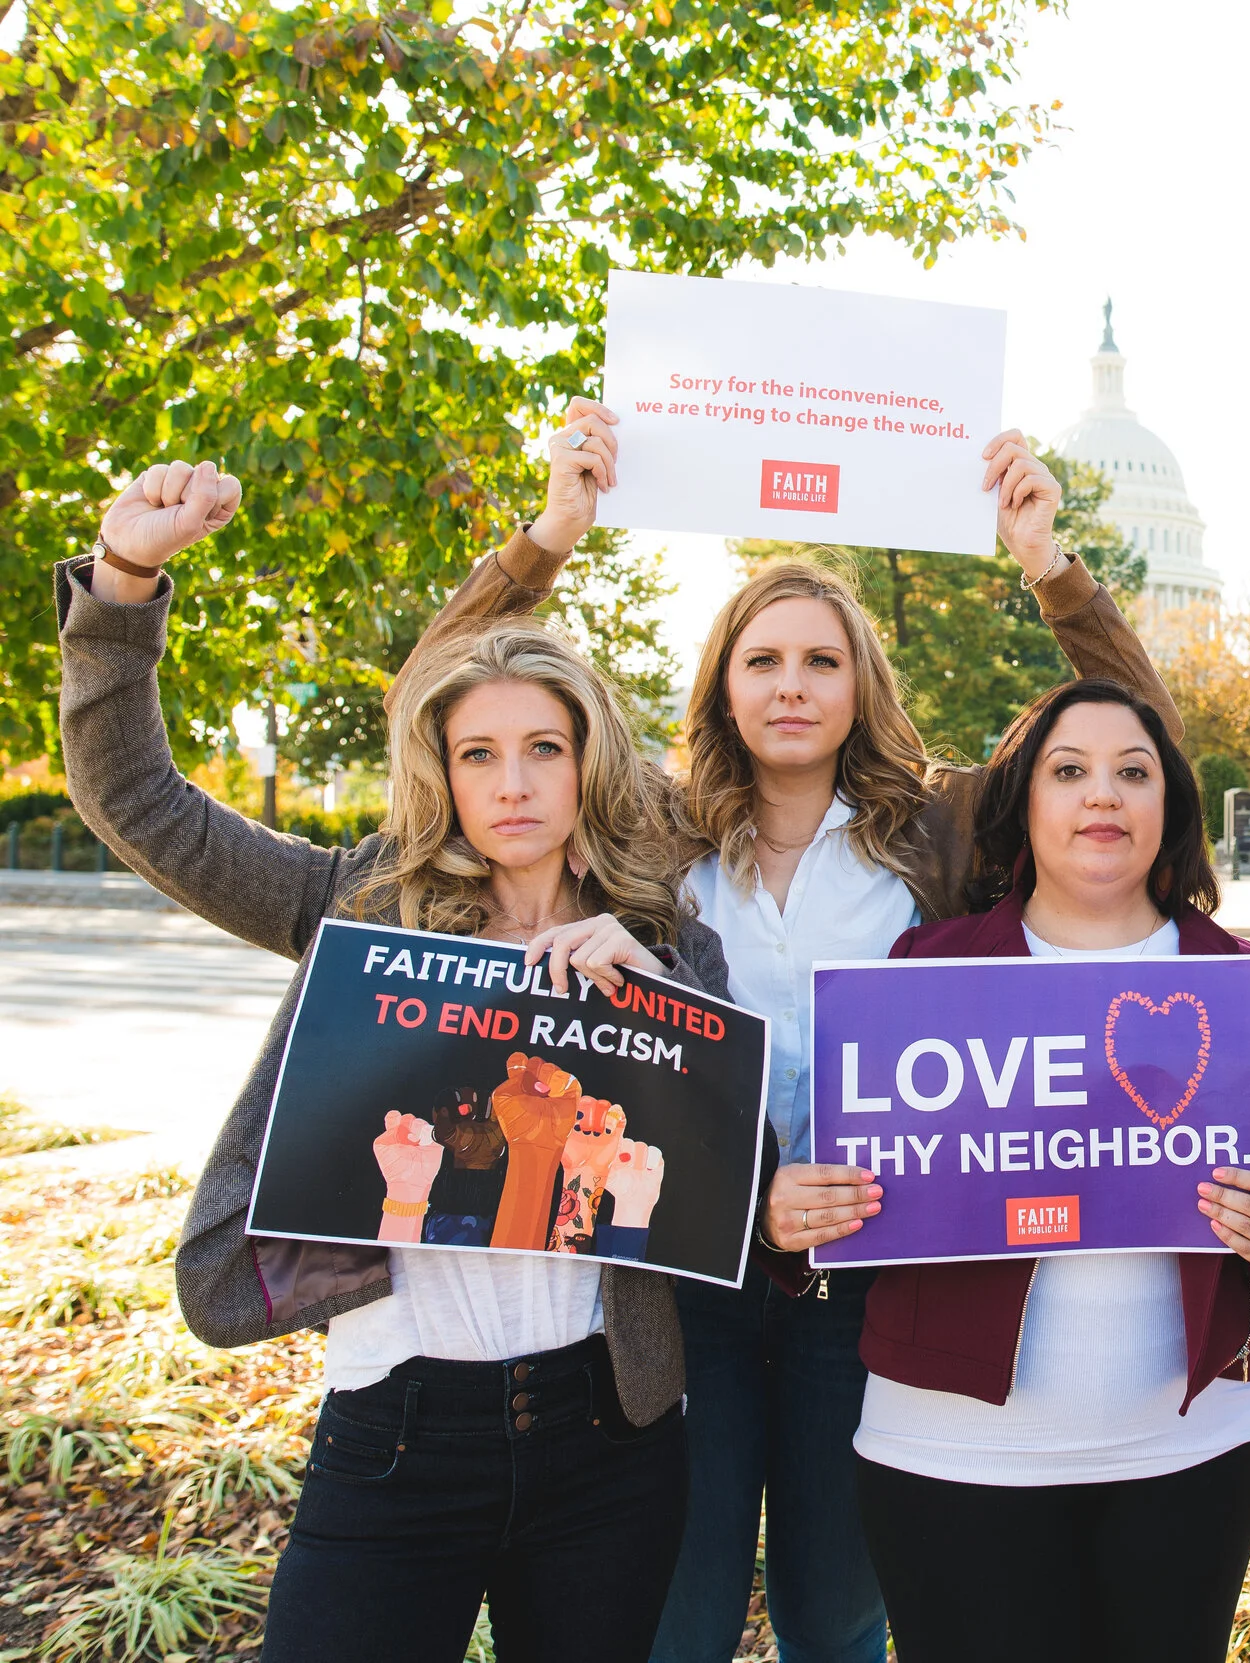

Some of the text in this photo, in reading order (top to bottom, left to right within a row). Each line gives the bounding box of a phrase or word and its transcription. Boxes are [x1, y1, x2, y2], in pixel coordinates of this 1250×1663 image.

[669, 374, 944, 414] Sorry for the inconvenience,
[635, 400, 970, 440] we are trying to change the world.
[773, 472, 827, 493] FAITH
[773, 491, 826, 502] IN PUBLIC LIFE
[609, 982, 726, 1042] UNITED
[375, 994, 689, 1074] TO END RACISM.
[841, 1035, 1089, 1114] LOVE
[836, 1134, 943, 1177] THY
[1018, 1207, 1068, 1226] FAITH
[1018, 1227, 1025, 1235] IN
[1028, 1226, 1052, 1234] PUBLIC
